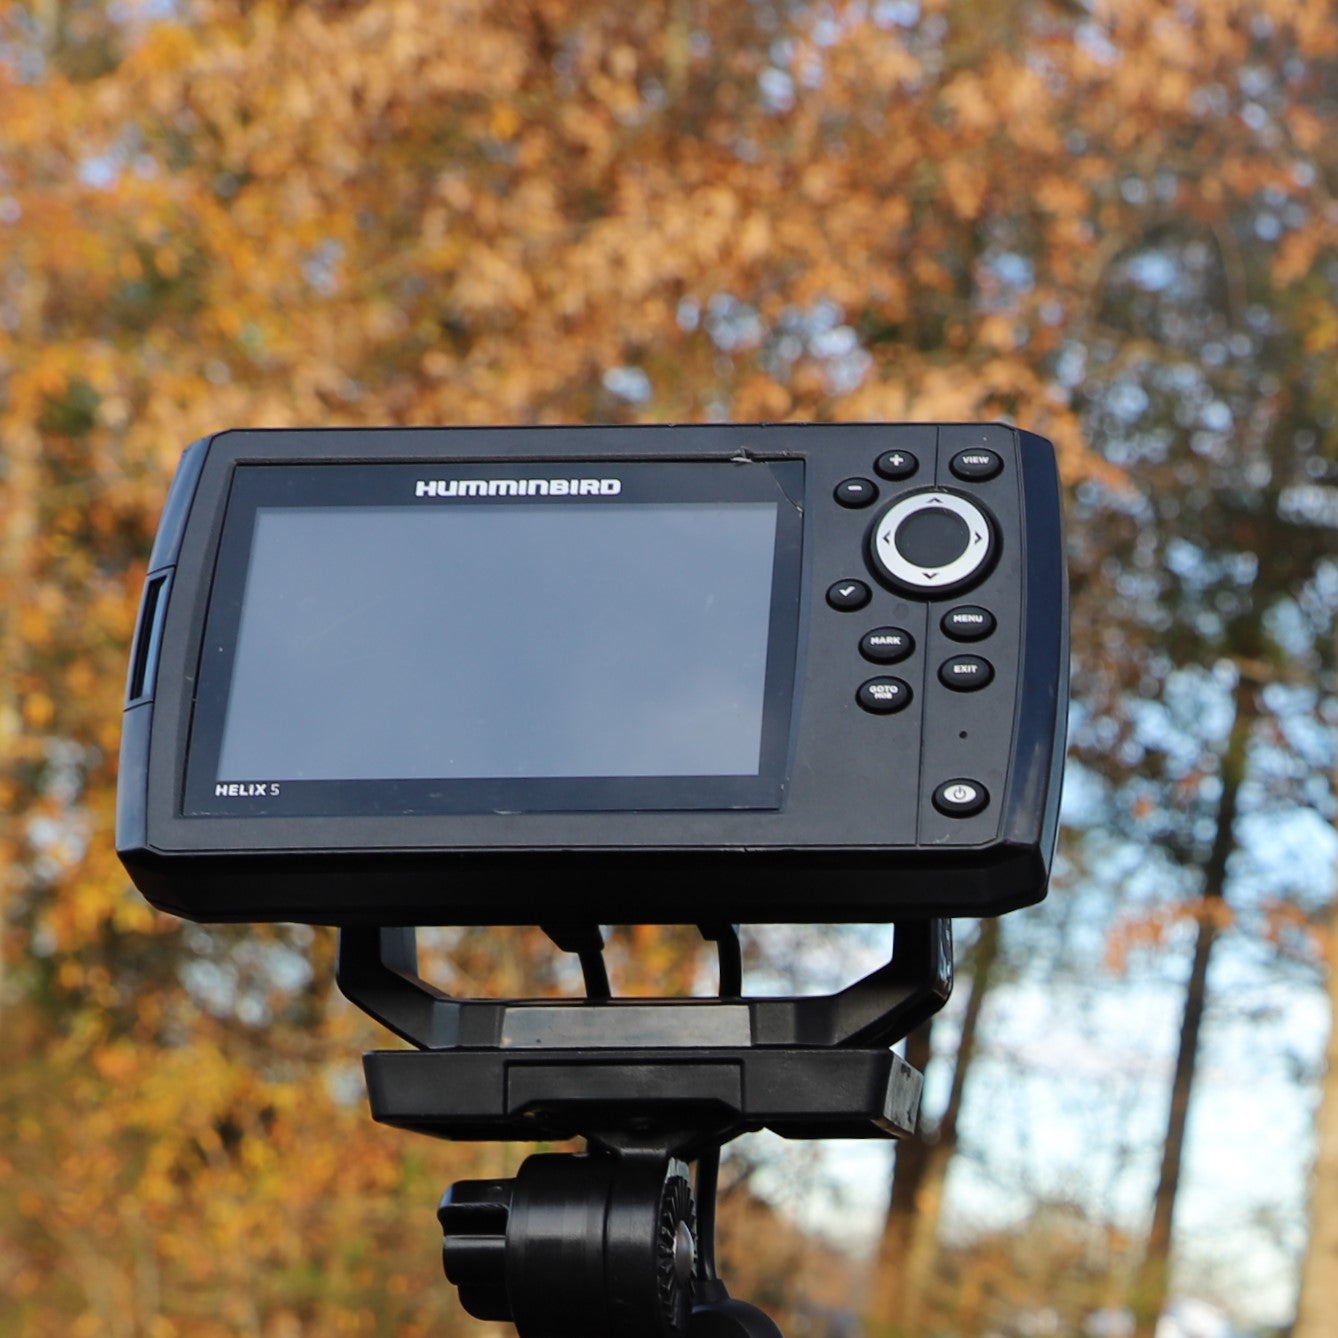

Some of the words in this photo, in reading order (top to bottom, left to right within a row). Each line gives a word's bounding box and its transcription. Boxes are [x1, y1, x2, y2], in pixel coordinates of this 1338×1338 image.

[962, 456, 990, 465] VIEW
[415, 479, 622, 497] HUMMINBIRD
[953, 614, 983, 624] MENU
[870, 636, 902, 646] MARK
[953, 665, 978, 674] EXIT
[869, 685, 899, 694] GOTO
[215, 783, 267, 797] HELIX
[269, 783, 280, 796] 5
